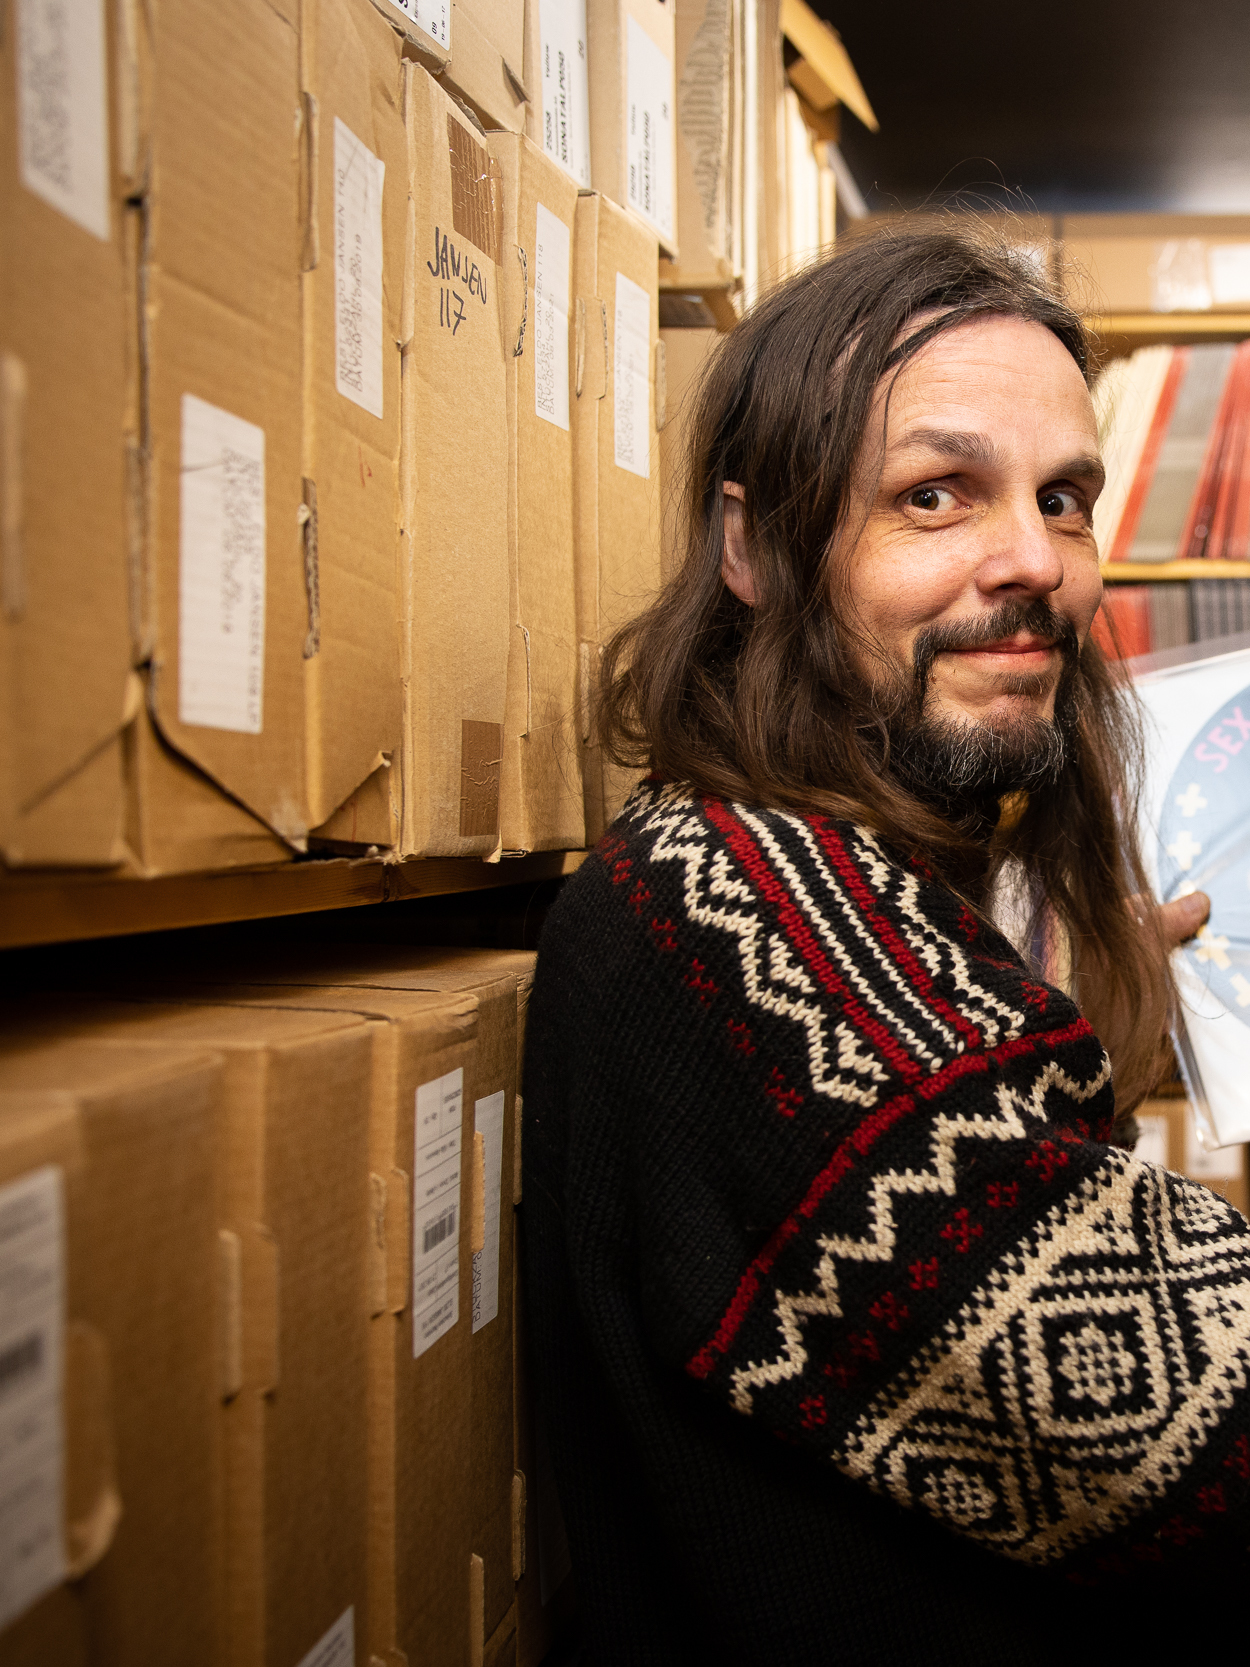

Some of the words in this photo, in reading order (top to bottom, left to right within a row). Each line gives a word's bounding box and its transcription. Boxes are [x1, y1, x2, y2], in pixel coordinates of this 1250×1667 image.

[337, 204, 345, 270] JANSEN
[427, 226, 487, 305] JANSEN
[440, 287, 467, 336] 117
